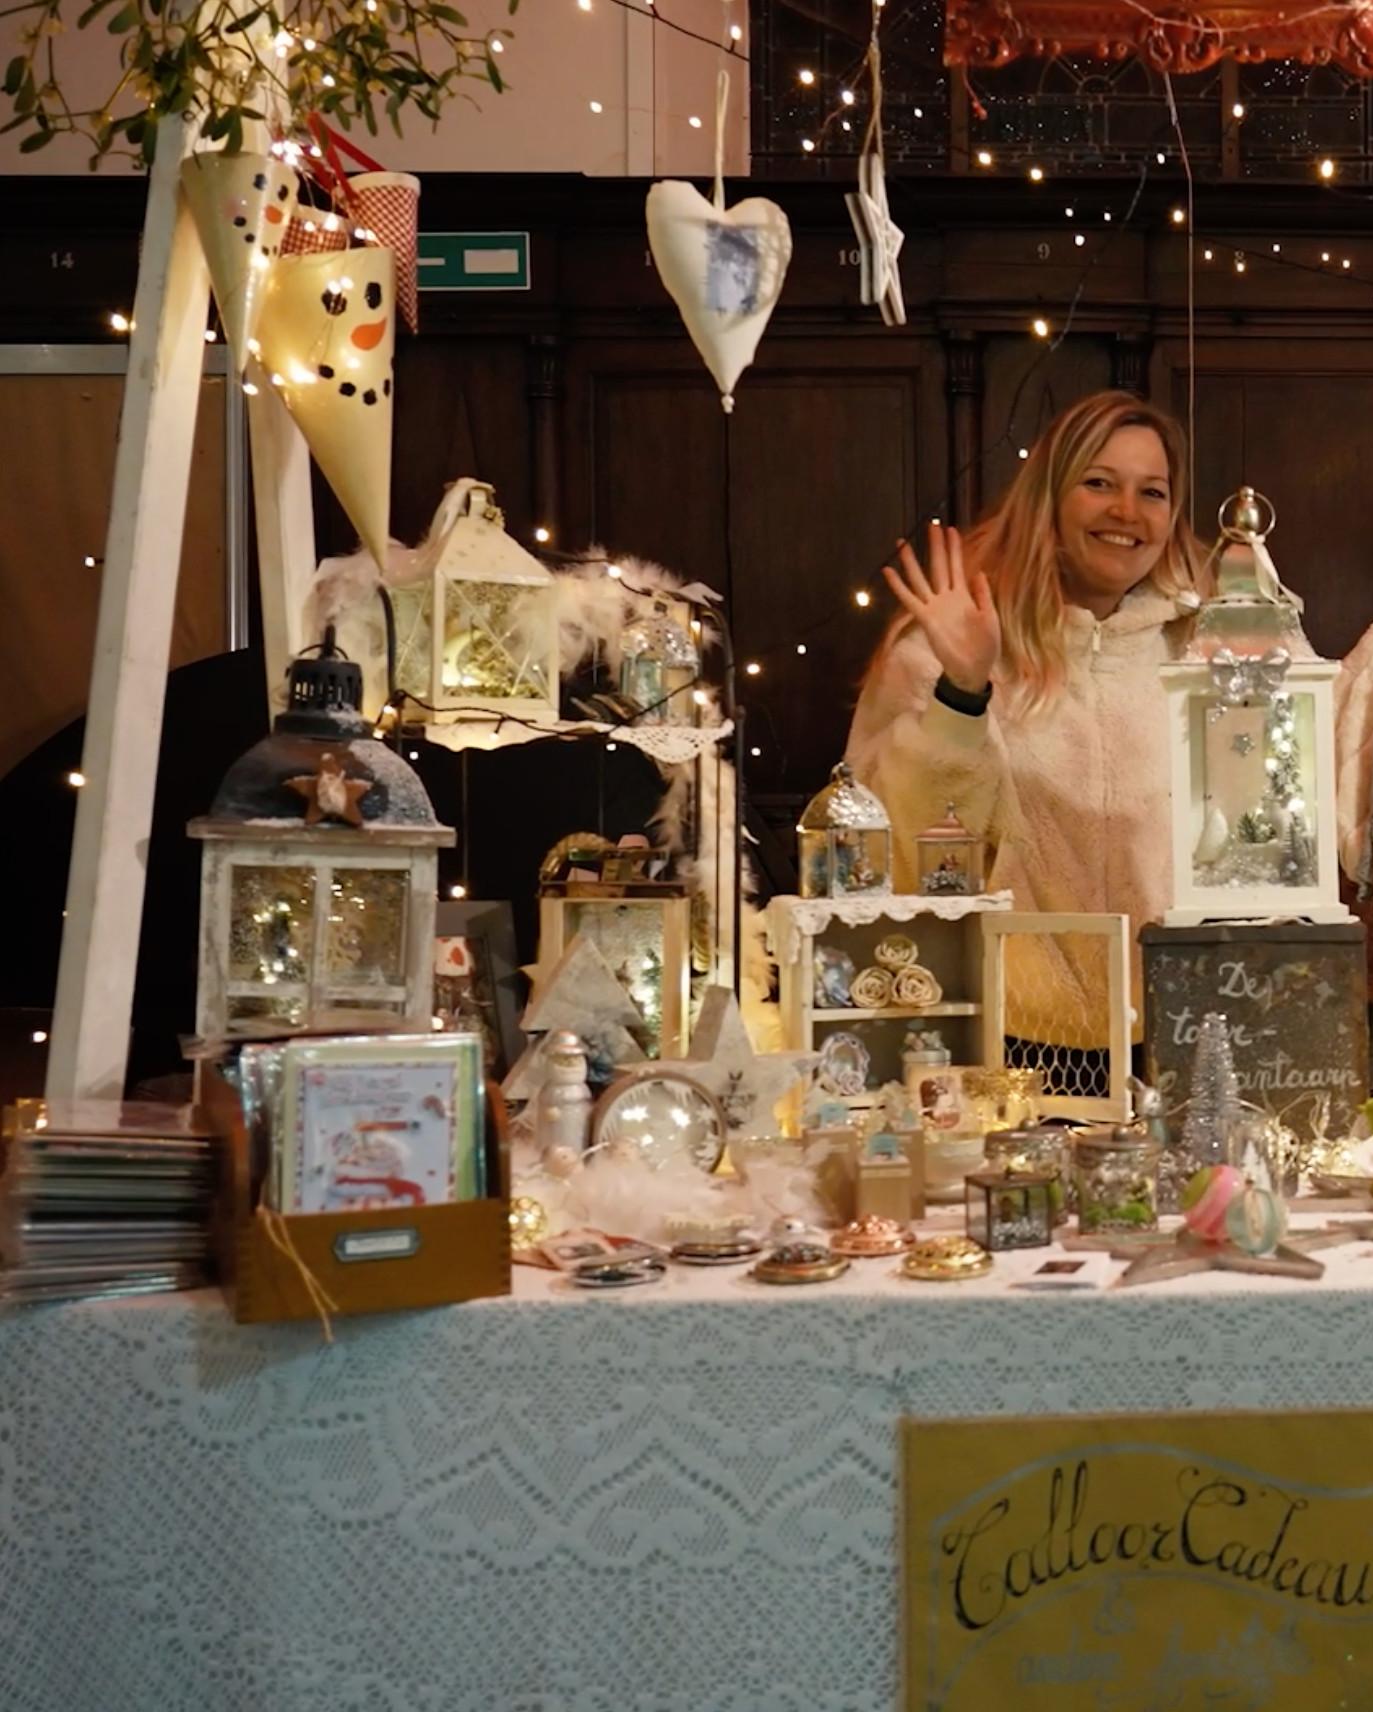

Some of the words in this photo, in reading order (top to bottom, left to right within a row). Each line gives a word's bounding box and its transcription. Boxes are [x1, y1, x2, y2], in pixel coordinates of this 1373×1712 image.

[838, 249, 861, 265] 10
[1037, 243, 1050, 260] 9
[50, 252, 74, 269] 14
[1217, 961, 1268, 1000] De
[1233, 1050, 1362, 1090] antaarn
